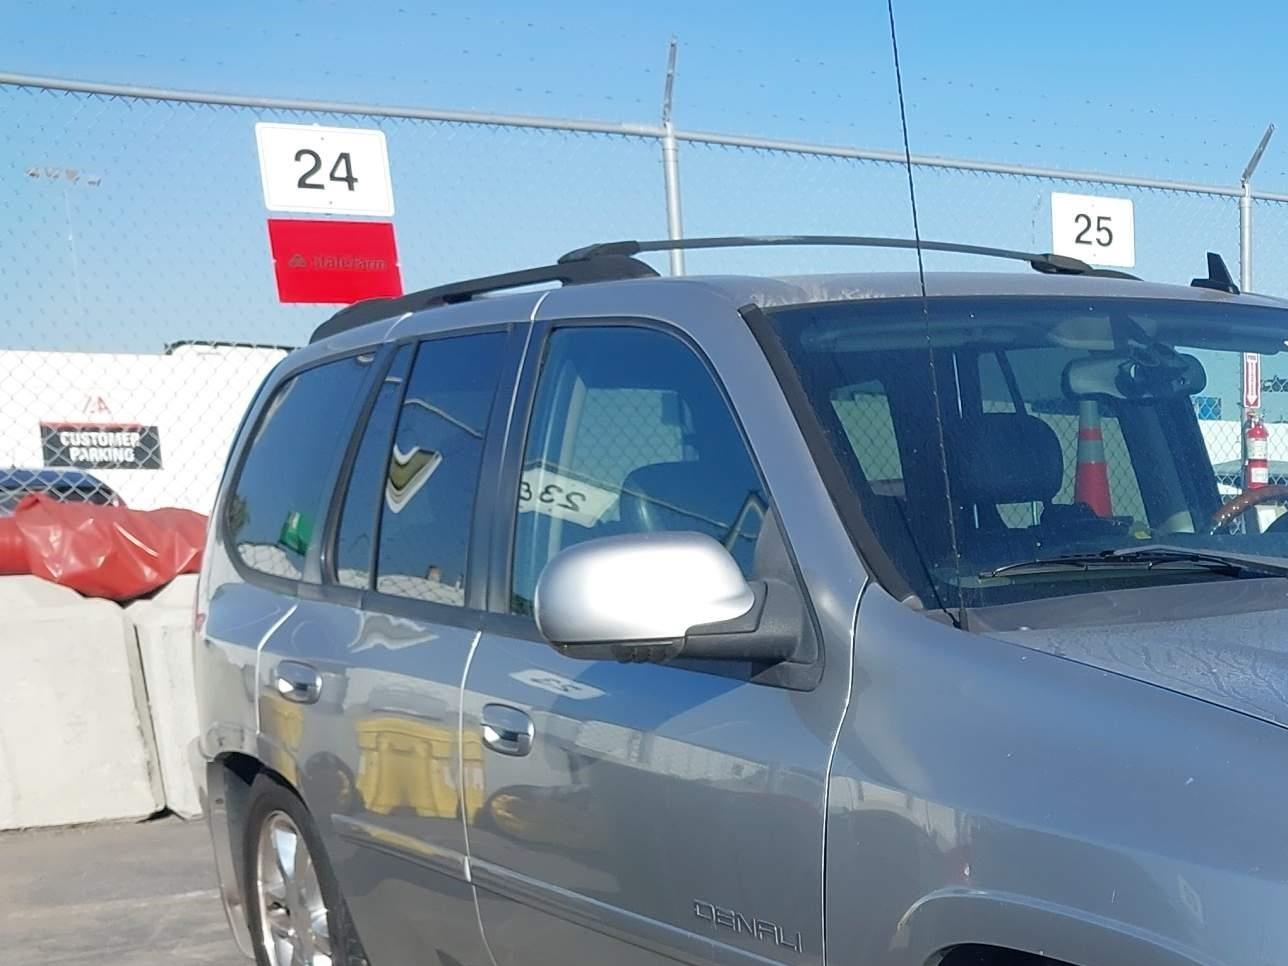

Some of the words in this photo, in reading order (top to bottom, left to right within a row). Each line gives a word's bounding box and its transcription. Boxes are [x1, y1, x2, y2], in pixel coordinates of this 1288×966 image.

[294, 148, 359, 192] 24
[1074, 213, 1114, 247] 25
[60, 430, 140, 448] CUSTOMER
[69, 446, 134, 462] PARKING
[694, 898, 803, 953] DENALI
